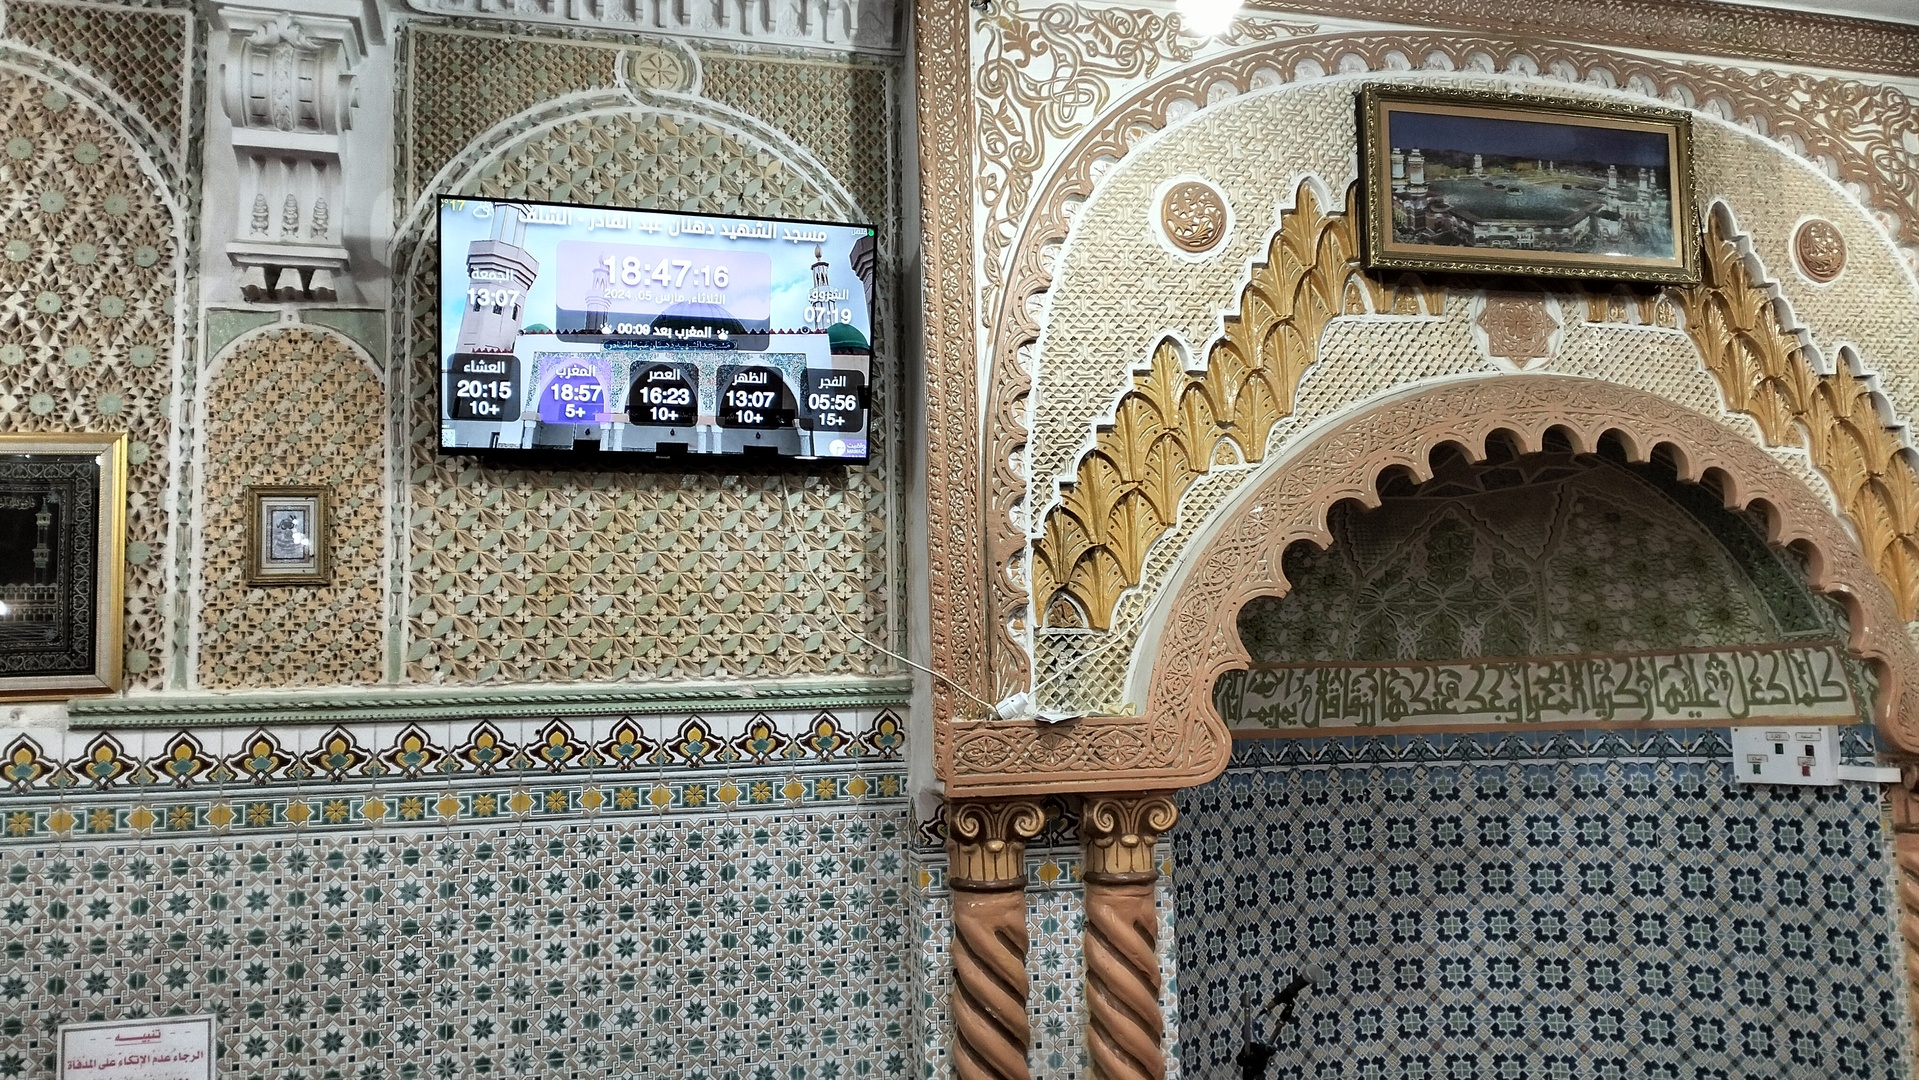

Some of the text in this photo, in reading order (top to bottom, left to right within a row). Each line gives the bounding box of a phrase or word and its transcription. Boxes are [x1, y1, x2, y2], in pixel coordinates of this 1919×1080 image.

[518, 207, 572, 226] الشلف
[587, 211, 632, 231] القادر
[637, 218, 664, 235] عبد
[719, 221, 777, 240] الشهيد
[782, 228, 828, 244] مسجد
[471, 268, 514, 283] الجمعة
[603, 255, 729, 289] 18:47:16
[467, 288, 520, 306] 13:07
[604, 289, 632, 300] 2024
[655, 292, 685, 305] مارس
[808, 289, 849, 304] الشروق
[804, 306, 852, 324] 07:19
[617, 322, 712, 340] المغرب بعد 00:09
[463, 360, 506, 374] العشاء
[555, 363, 597, 378] المغرب
[647, 368, 680, 382] العصر
[732, 372, 767, 386] الظهر
[818, 376, 846, 388] الفجر
[457, 380, 512, 399] 20:15
[551, 383, 602, 401] 18:57
[640, 387, 690, 405] 16:23
[726, 391, 775, 408] 13:07
[808, 394, 856, 411] 05:56
[1783, 646, 1849, 707] كلما
[98, 1056, 116, 1070] على
[152, 1053, 171, 1066] عدم
[173, 1048, 204, 1063] الرجاء
